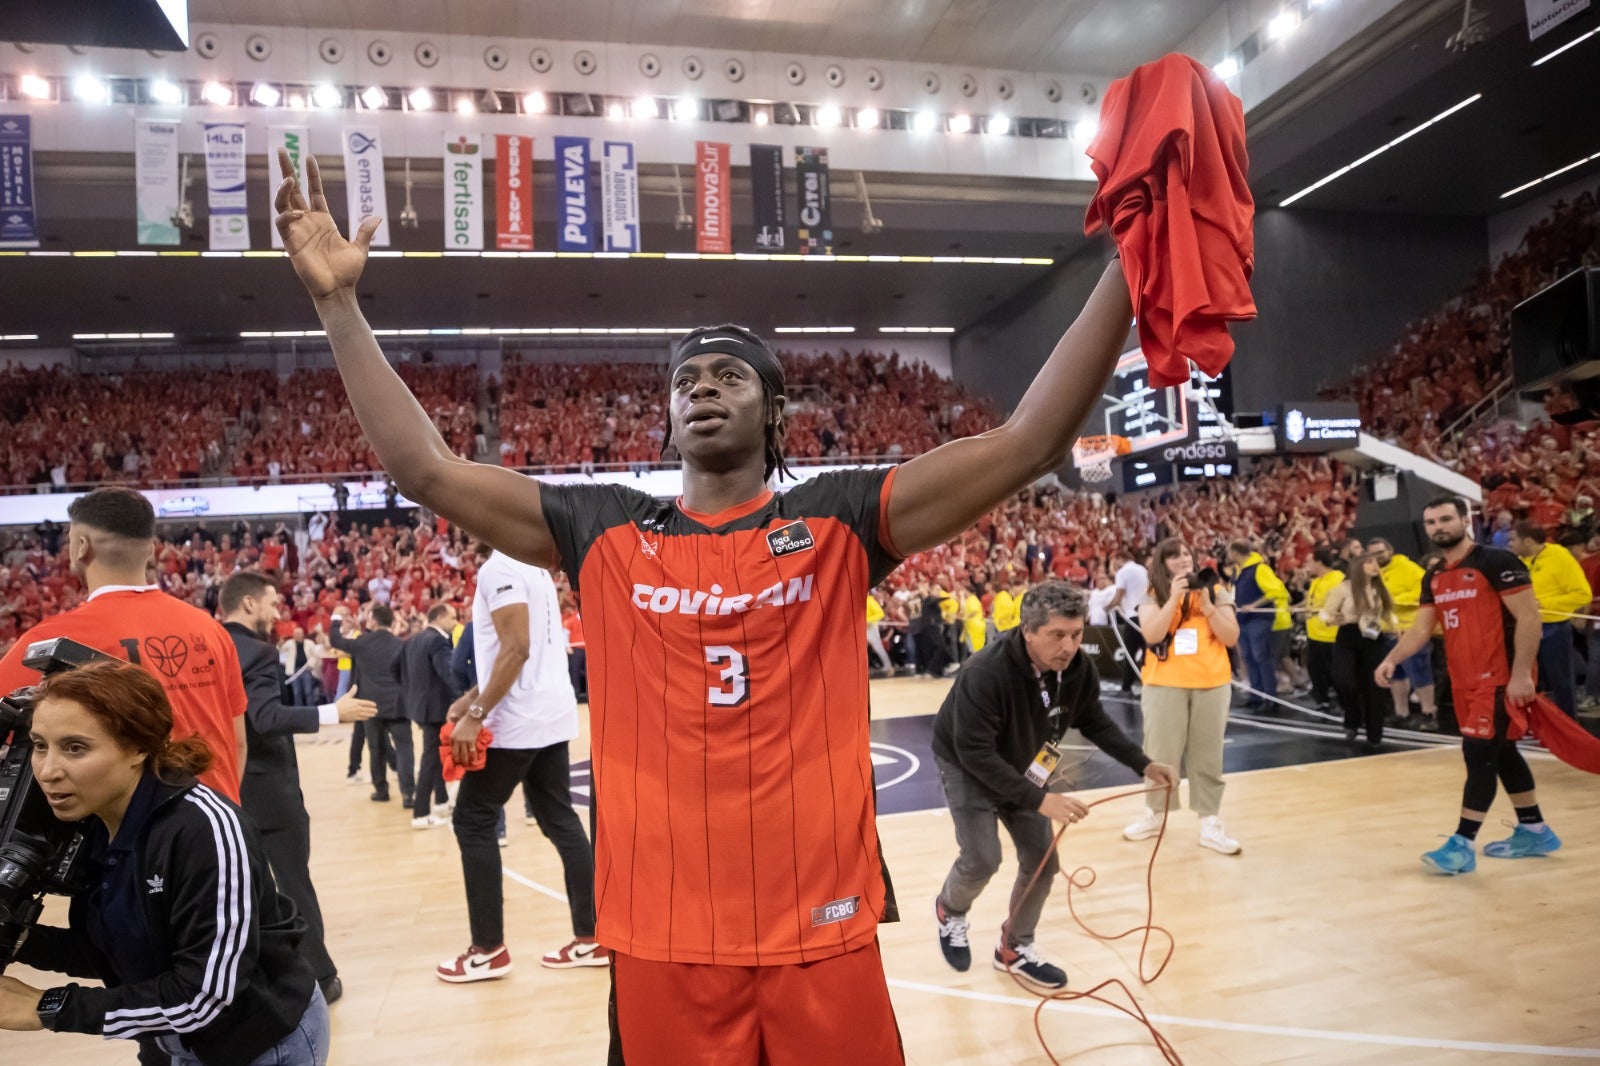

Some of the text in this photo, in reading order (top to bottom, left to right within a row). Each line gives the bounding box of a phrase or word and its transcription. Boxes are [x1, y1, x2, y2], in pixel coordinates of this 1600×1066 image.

[357, 158, 376, 223] emasa
[454, 160, 472, 246] fertisac
[564, 145, 588, 245] PULEVA
[614, 171, 628, 222] ABOGADOS
[700, 142, 719, 238] innovaSur
[1163, 443, 1226, 461] endesa
[772, 535, 790, 549] liga
[775, 537, 812, 553] endesa
[1442, 608, 1460, 630] 15
[704, 645, 751, 708] 3
[825, 901, 854, 920] FCBG
